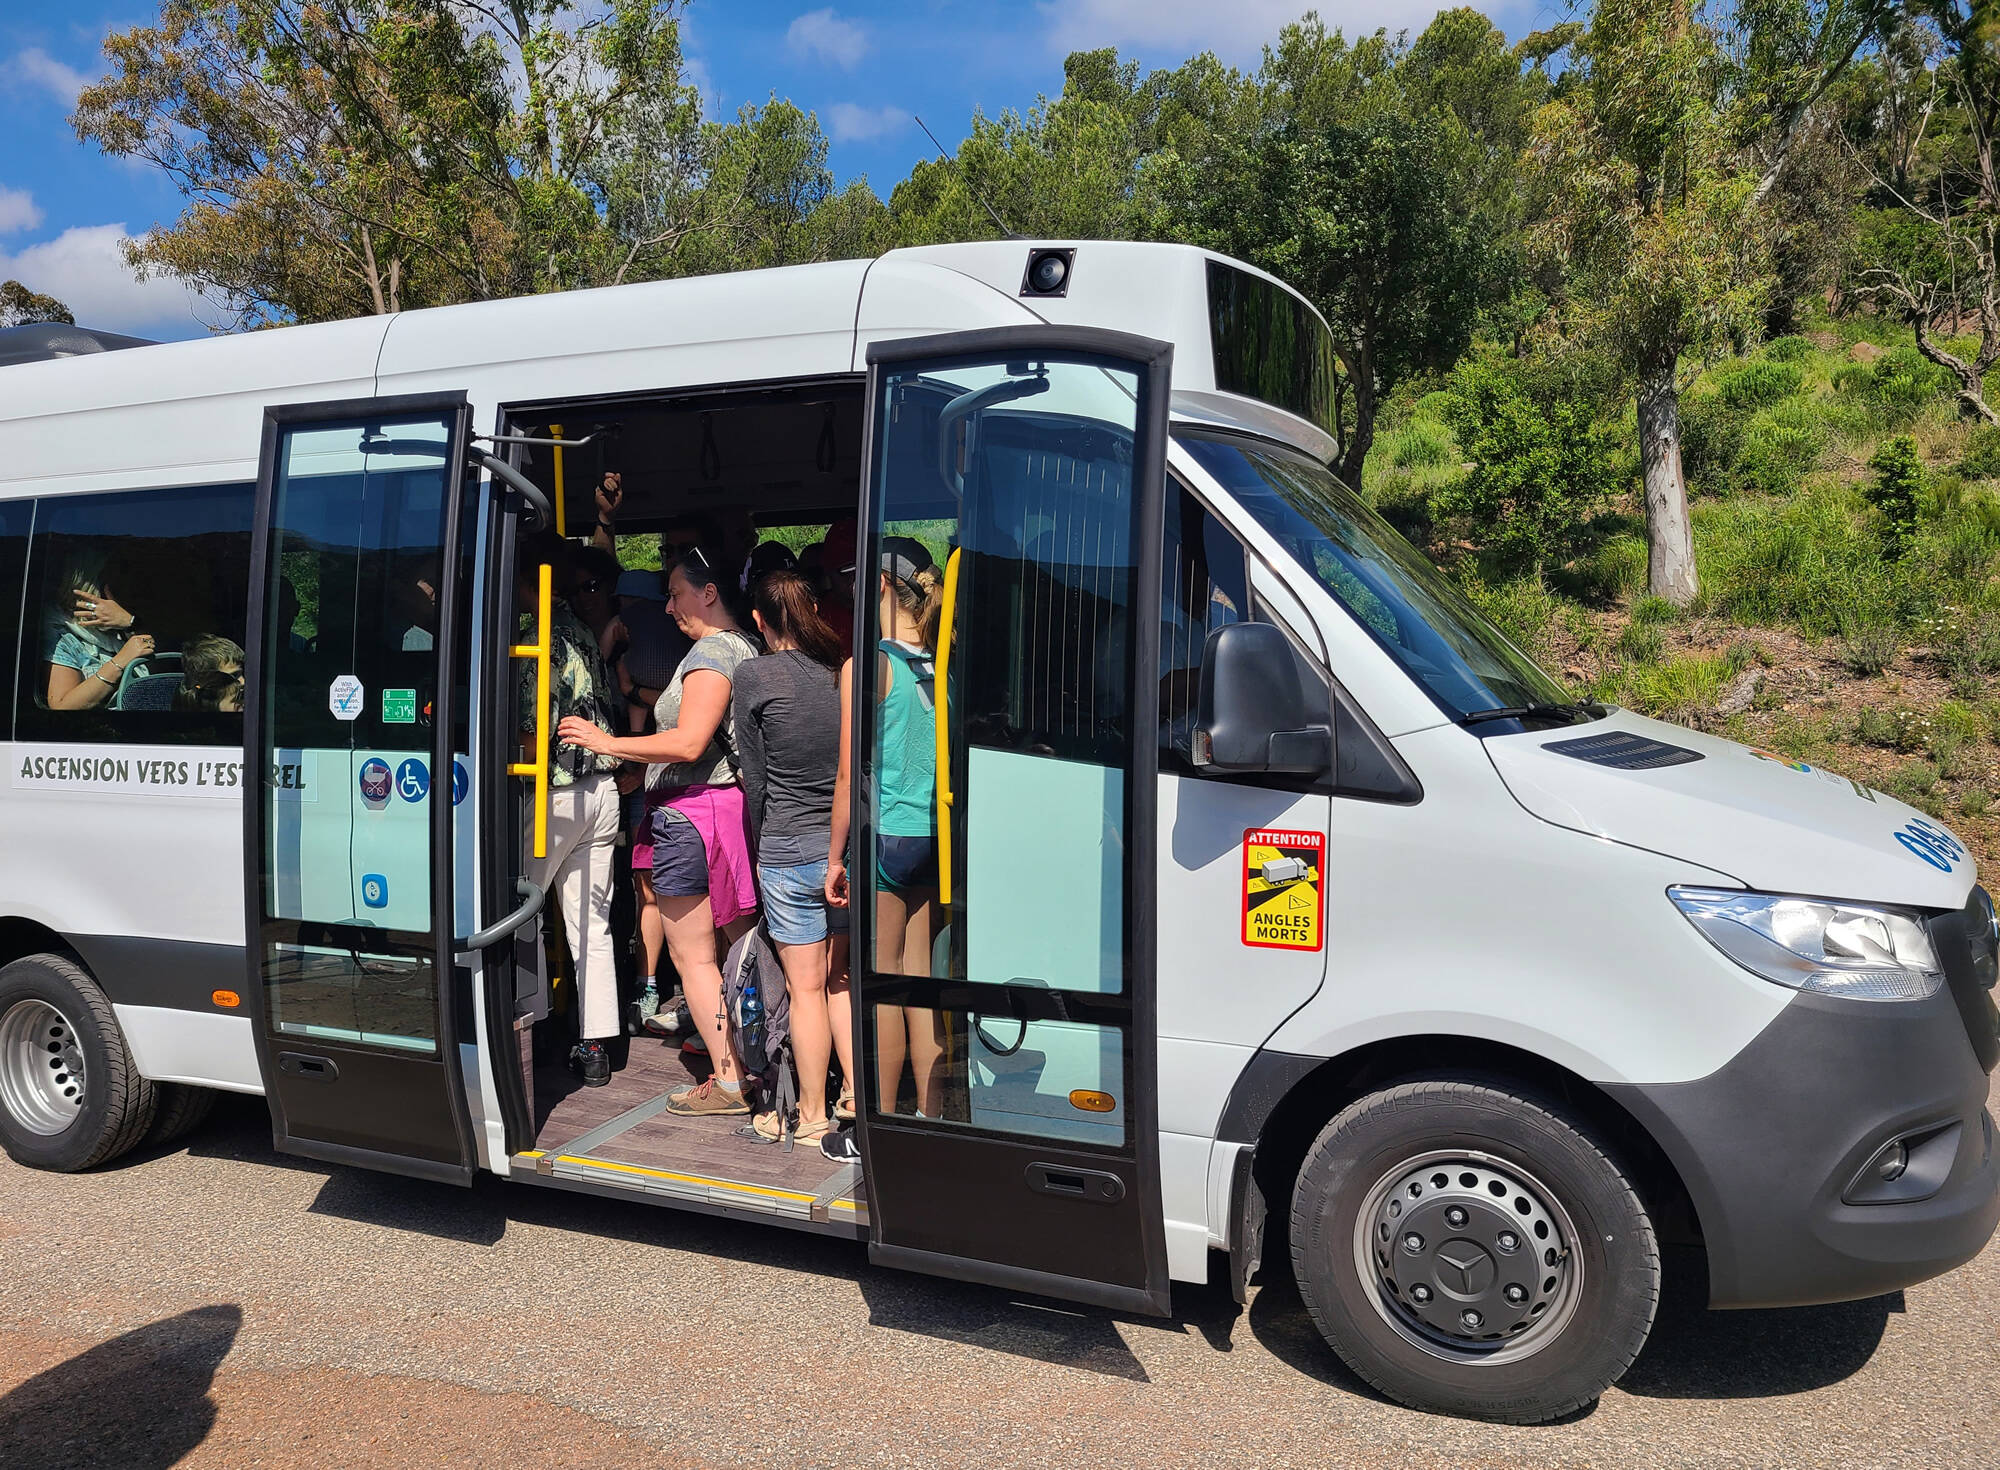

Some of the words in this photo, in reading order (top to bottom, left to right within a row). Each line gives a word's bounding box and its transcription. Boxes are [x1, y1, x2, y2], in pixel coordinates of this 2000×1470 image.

[21, 756, 129, 782] ASCENSION
[137, 760, 188, 785] VERS
[196, 762, 306, 790] L'ESREL
[1248, 832, 1320, 846] ATTENTION
[1254, 913, 1311, 928] ANGLES
[1257, 927, 1308, 941] MORTS
